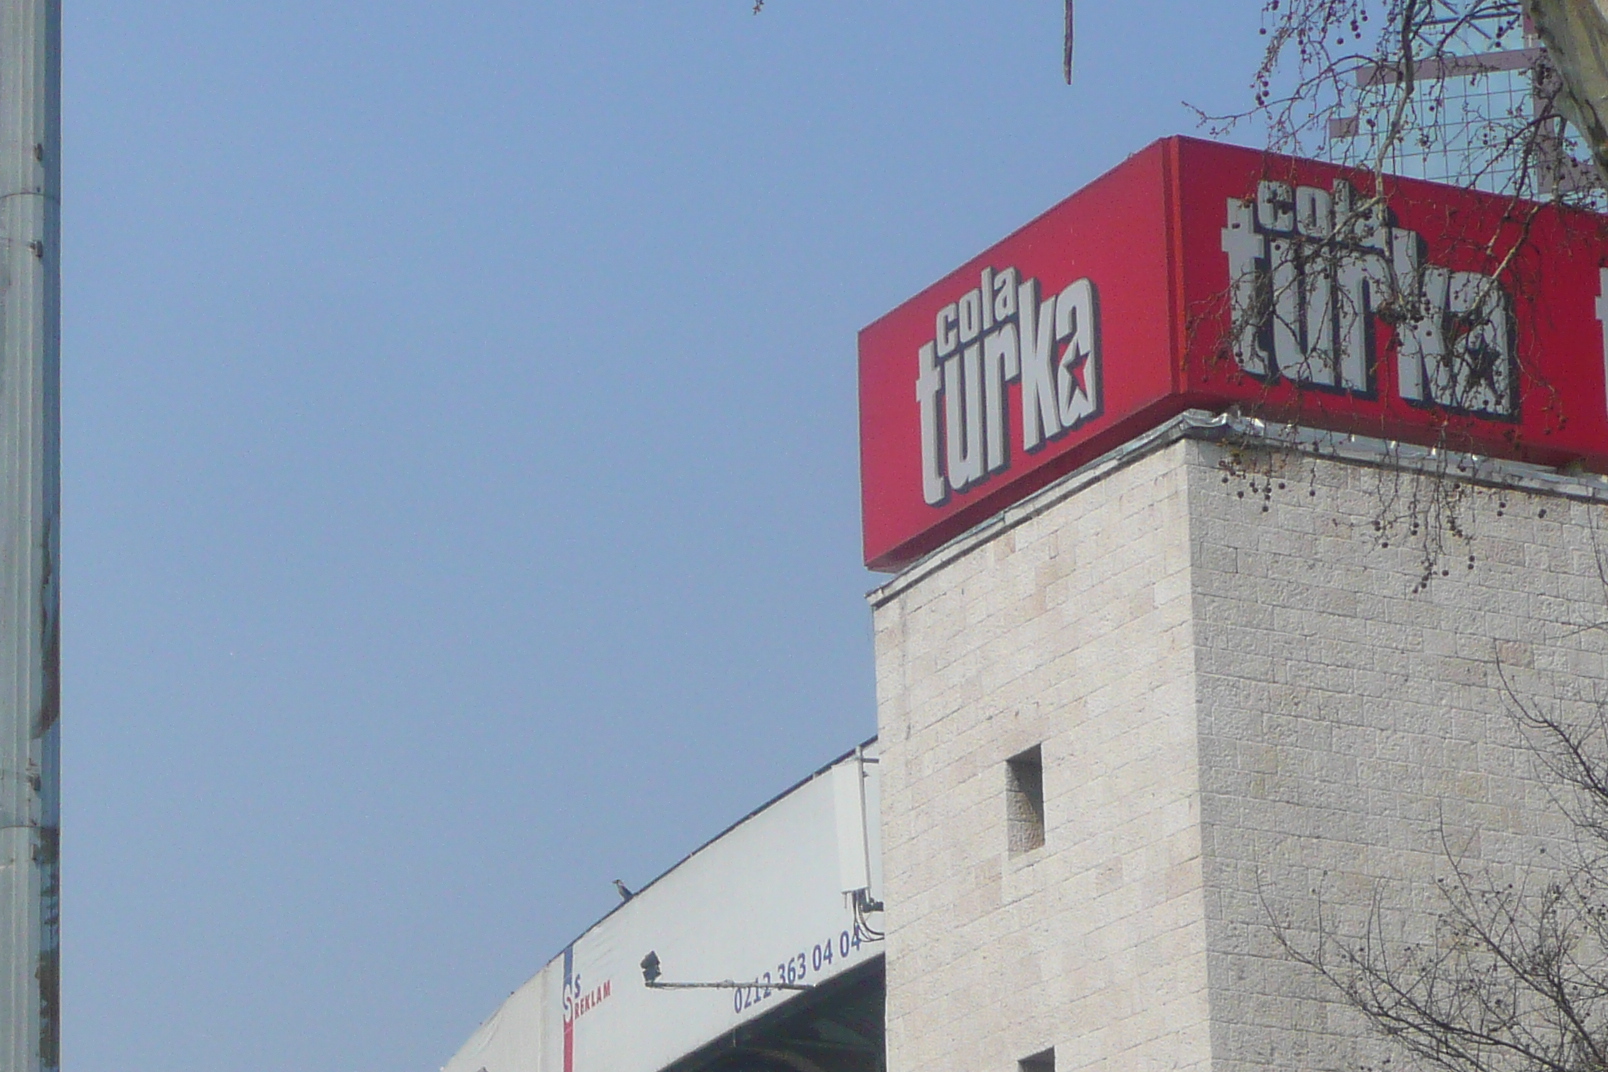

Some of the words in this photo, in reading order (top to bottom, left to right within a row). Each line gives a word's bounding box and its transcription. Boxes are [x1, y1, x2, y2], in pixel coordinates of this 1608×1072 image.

[1257, 178, 1389, 250] cola
[936, 266, 1018, 357] cola
[574, 979, 611, 1020] REKLAM
[734, 971, 772, 1014] 0212
[777, 952, 807, 991] 363
[812, 937, 833, 972] 04
[839, 924, 862, 958] 04
